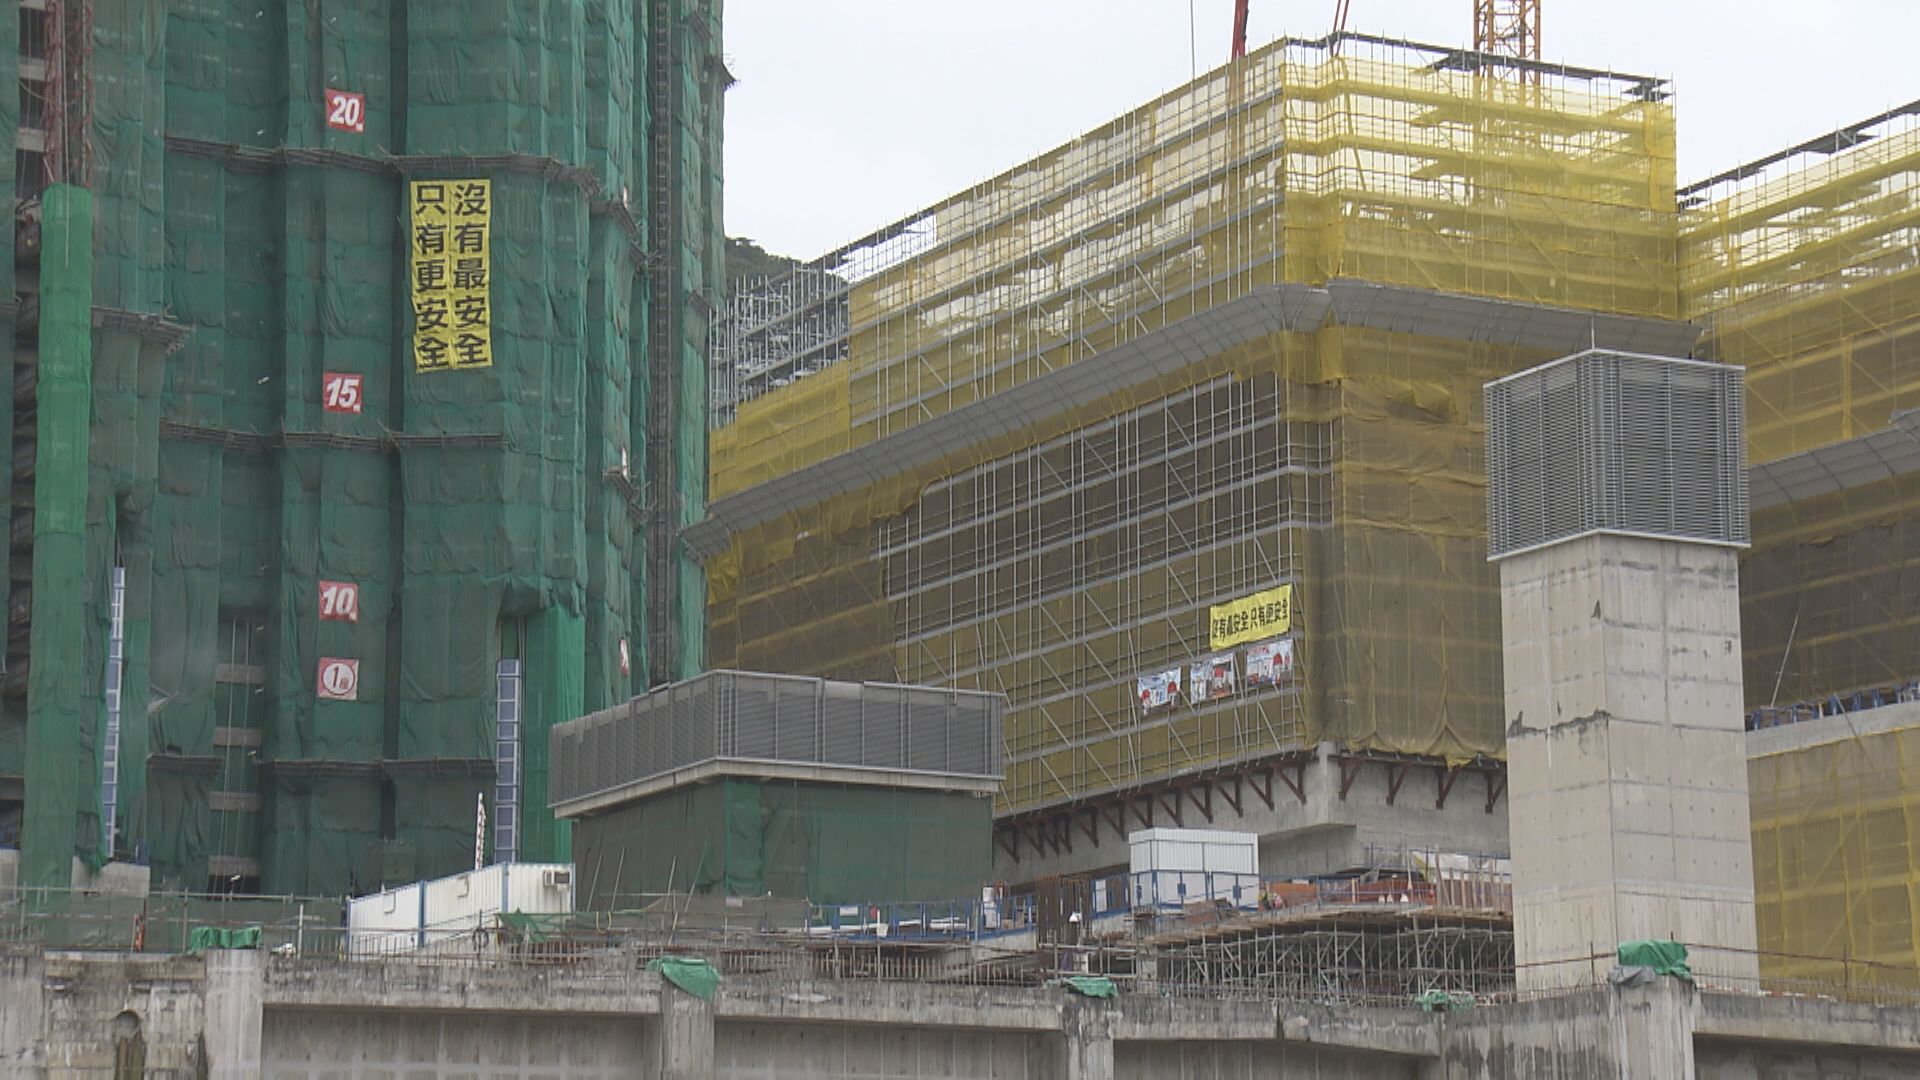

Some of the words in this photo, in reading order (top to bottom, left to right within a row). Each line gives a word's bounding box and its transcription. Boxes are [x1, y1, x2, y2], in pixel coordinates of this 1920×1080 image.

[330, 95, 360, 126] 20
[415, 184, 449, 368] 只有更安全
[454, 183, 488, 365] 沒有最安全
[327, 377, 360, 408] 15
[323, 586, 355, 615] 10
